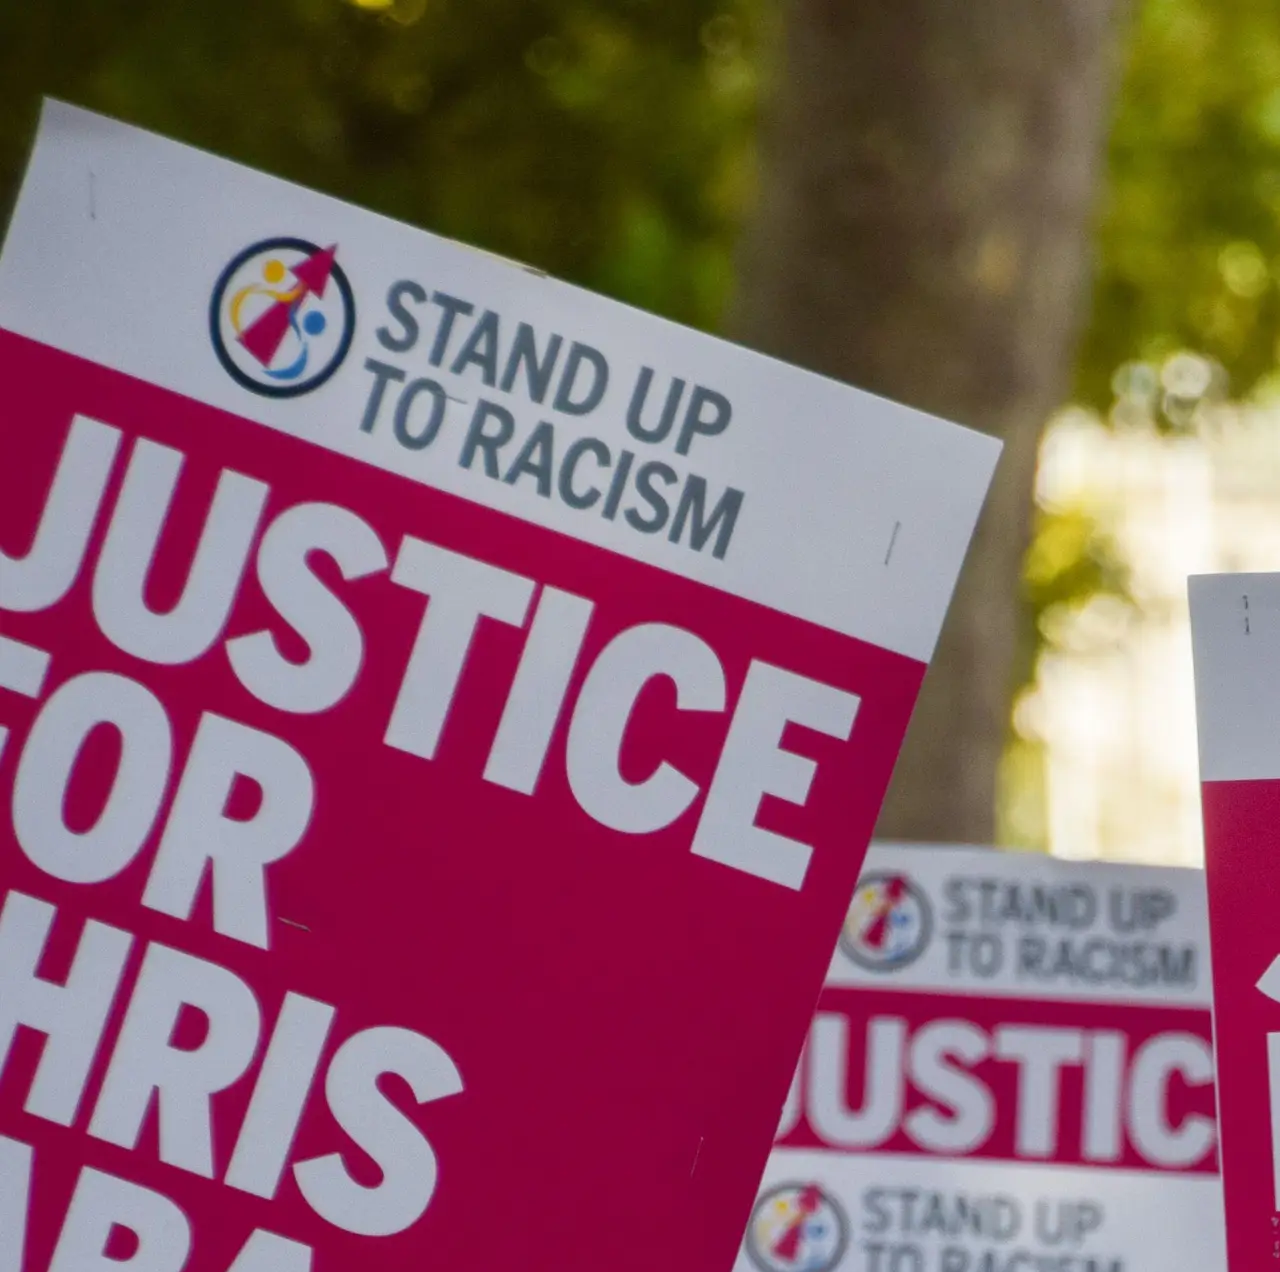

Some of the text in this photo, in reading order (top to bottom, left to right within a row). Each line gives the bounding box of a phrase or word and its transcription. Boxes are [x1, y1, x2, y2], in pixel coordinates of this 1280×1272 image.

[374, 279, 732, 457] STAND UP
[358, 357, 745, 560] TO RACISM
[0, 413, 862, 891] JUSTICE
[0, 634, 315, 950] OR
[942, 875, 1176, 934] STAND UP
[942, 931, 1198, 989] TO RACISM
[774, 1010, 1216, 1169] USTIC
[861, 1183, 1104, 1247] STAND UP
